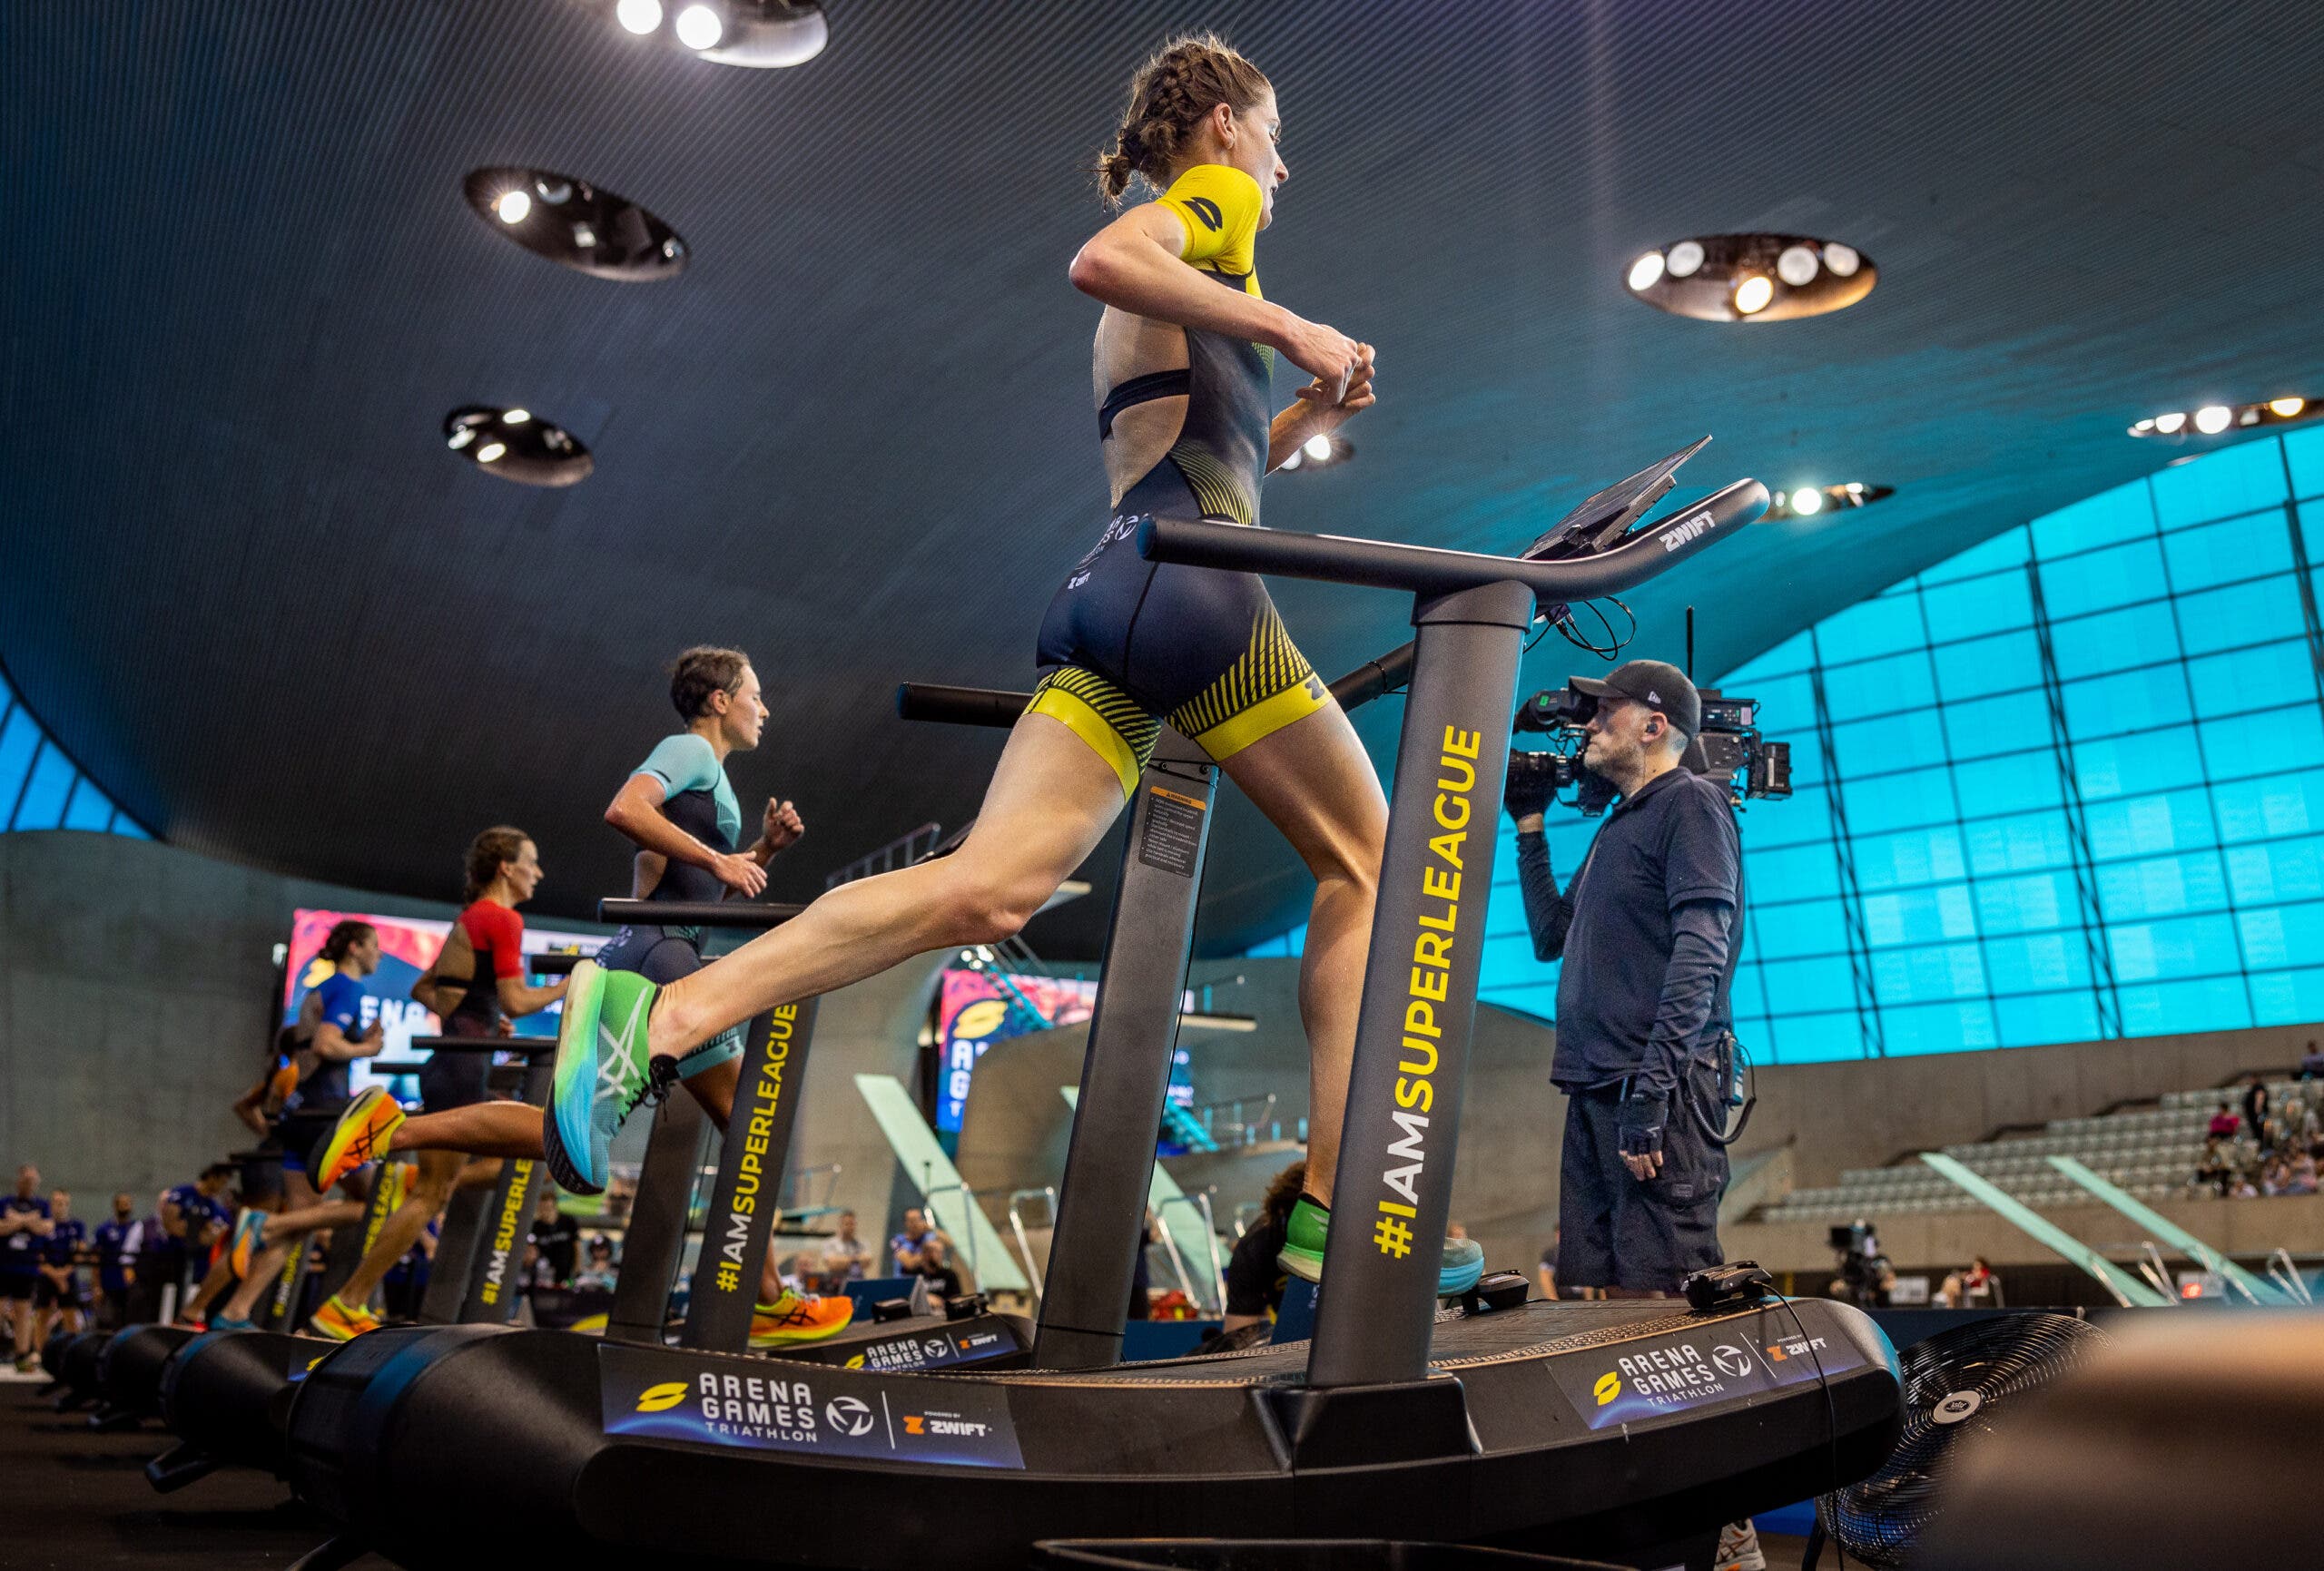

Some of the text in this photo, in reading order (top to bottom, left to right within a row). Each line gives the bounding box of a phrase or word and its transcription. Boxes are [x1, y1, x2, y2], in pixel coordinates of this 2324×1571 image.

[1659, 510, 1715, 552] ZWIFT
[1374, 725, 1481, 1259] #IAMSUPERLEAGUE
[716, 1003, 797, 1292] #IAMSUPERLEAGUE
[1618, 1344, 1702, 1377] ARENA
[1785, 1337, 1827, 1356] ZWFT
[698, 1371, 812, 1406] ARENA
[1632, 1363, 1716, 1395] GAMES
[1646, 1382, 1725, 1407] TRIATHLON
[701, 1396, 816, 1429] GAMES
[930, 1419, 987, 1438] ZWIFT
[704, 1420, 818, 1443] TRIATHLON
